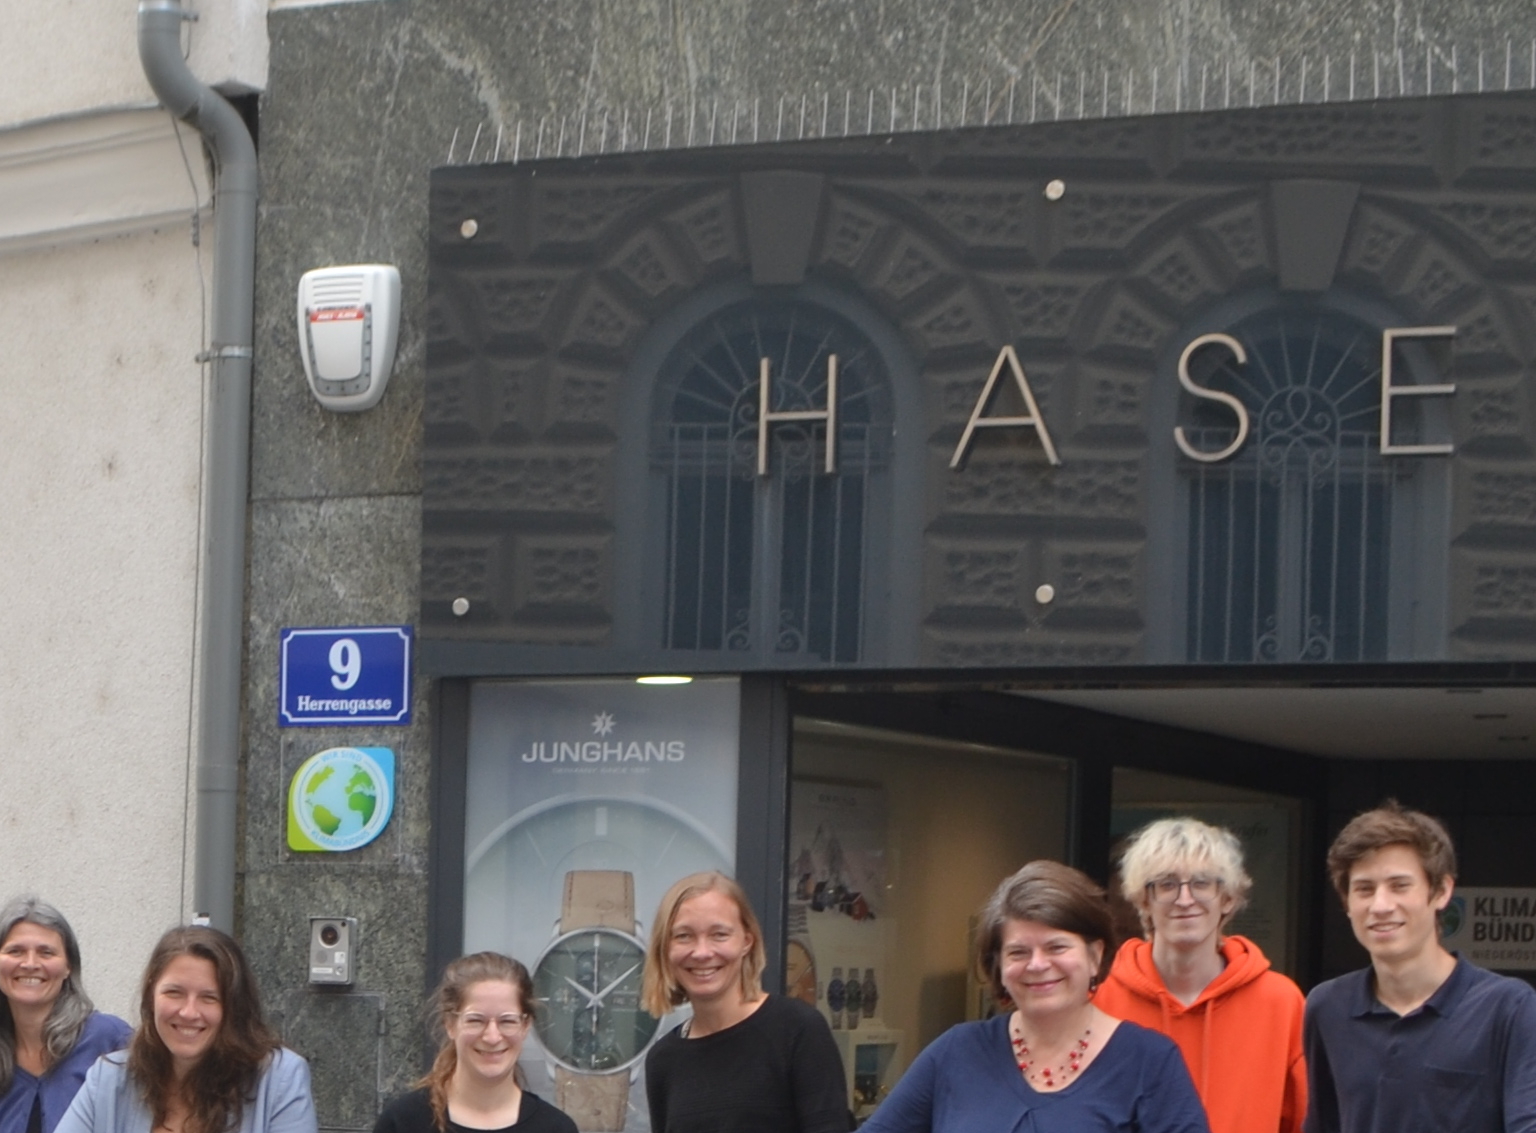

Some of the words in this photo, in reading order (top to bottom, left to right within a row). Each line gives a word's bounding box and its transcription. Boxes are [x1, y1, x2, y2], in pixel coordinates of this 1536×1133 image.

[757, 327, 1457, 475] HASE
[329, 638, 362, 691] 9
[297, 695, 392, 715] Herrengasse
[522, 740, 686, 763] JUNGHANS
